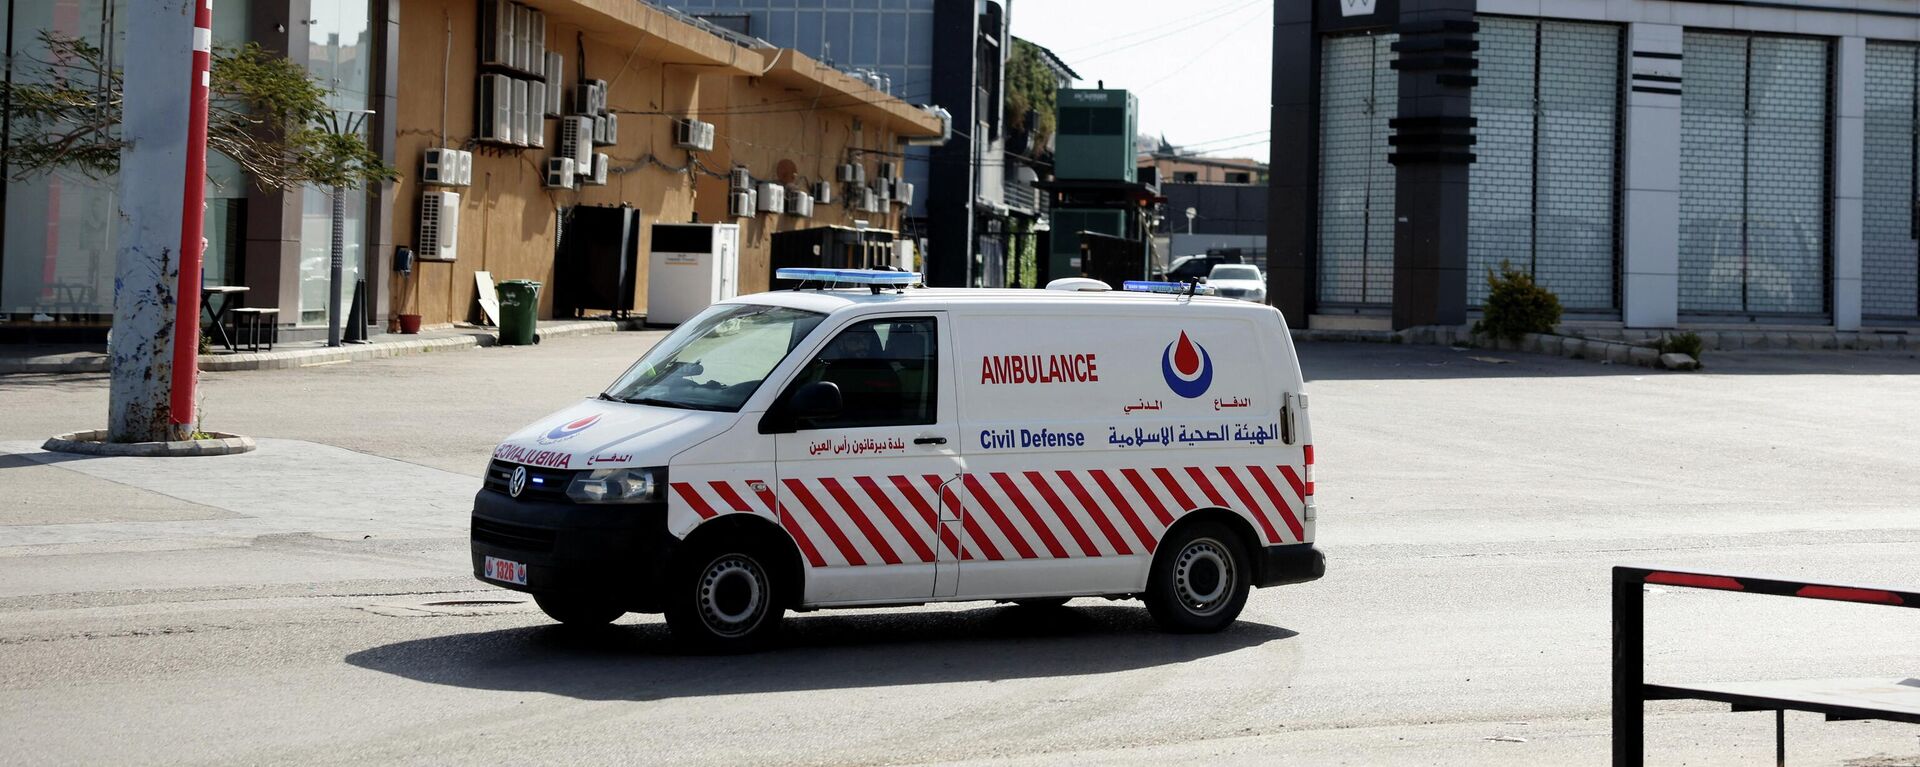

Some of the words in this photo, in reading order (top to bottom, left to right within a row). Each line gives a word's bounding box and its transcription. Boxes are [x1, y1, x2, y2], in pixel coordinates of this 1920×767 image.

[981, 354, 1098, 384] AMBULANCE
[1124, 398, 1163, 415] المدني
[1214, 396, 1251, 411] الدفاع
[980, 430, 1015, 449] Civil
[1021, 429, 1085, 448] Defense
[1109, 425, 1174, 448] الاسلامية
[1178, 424, 1229, 446] الصحية
[1234, 423, 1278, 445] الهيئة
[809, 439, 832, 455] العين
[587, 453, 632, 465] الدفاع
[496, 561, 513, 581] 1326
